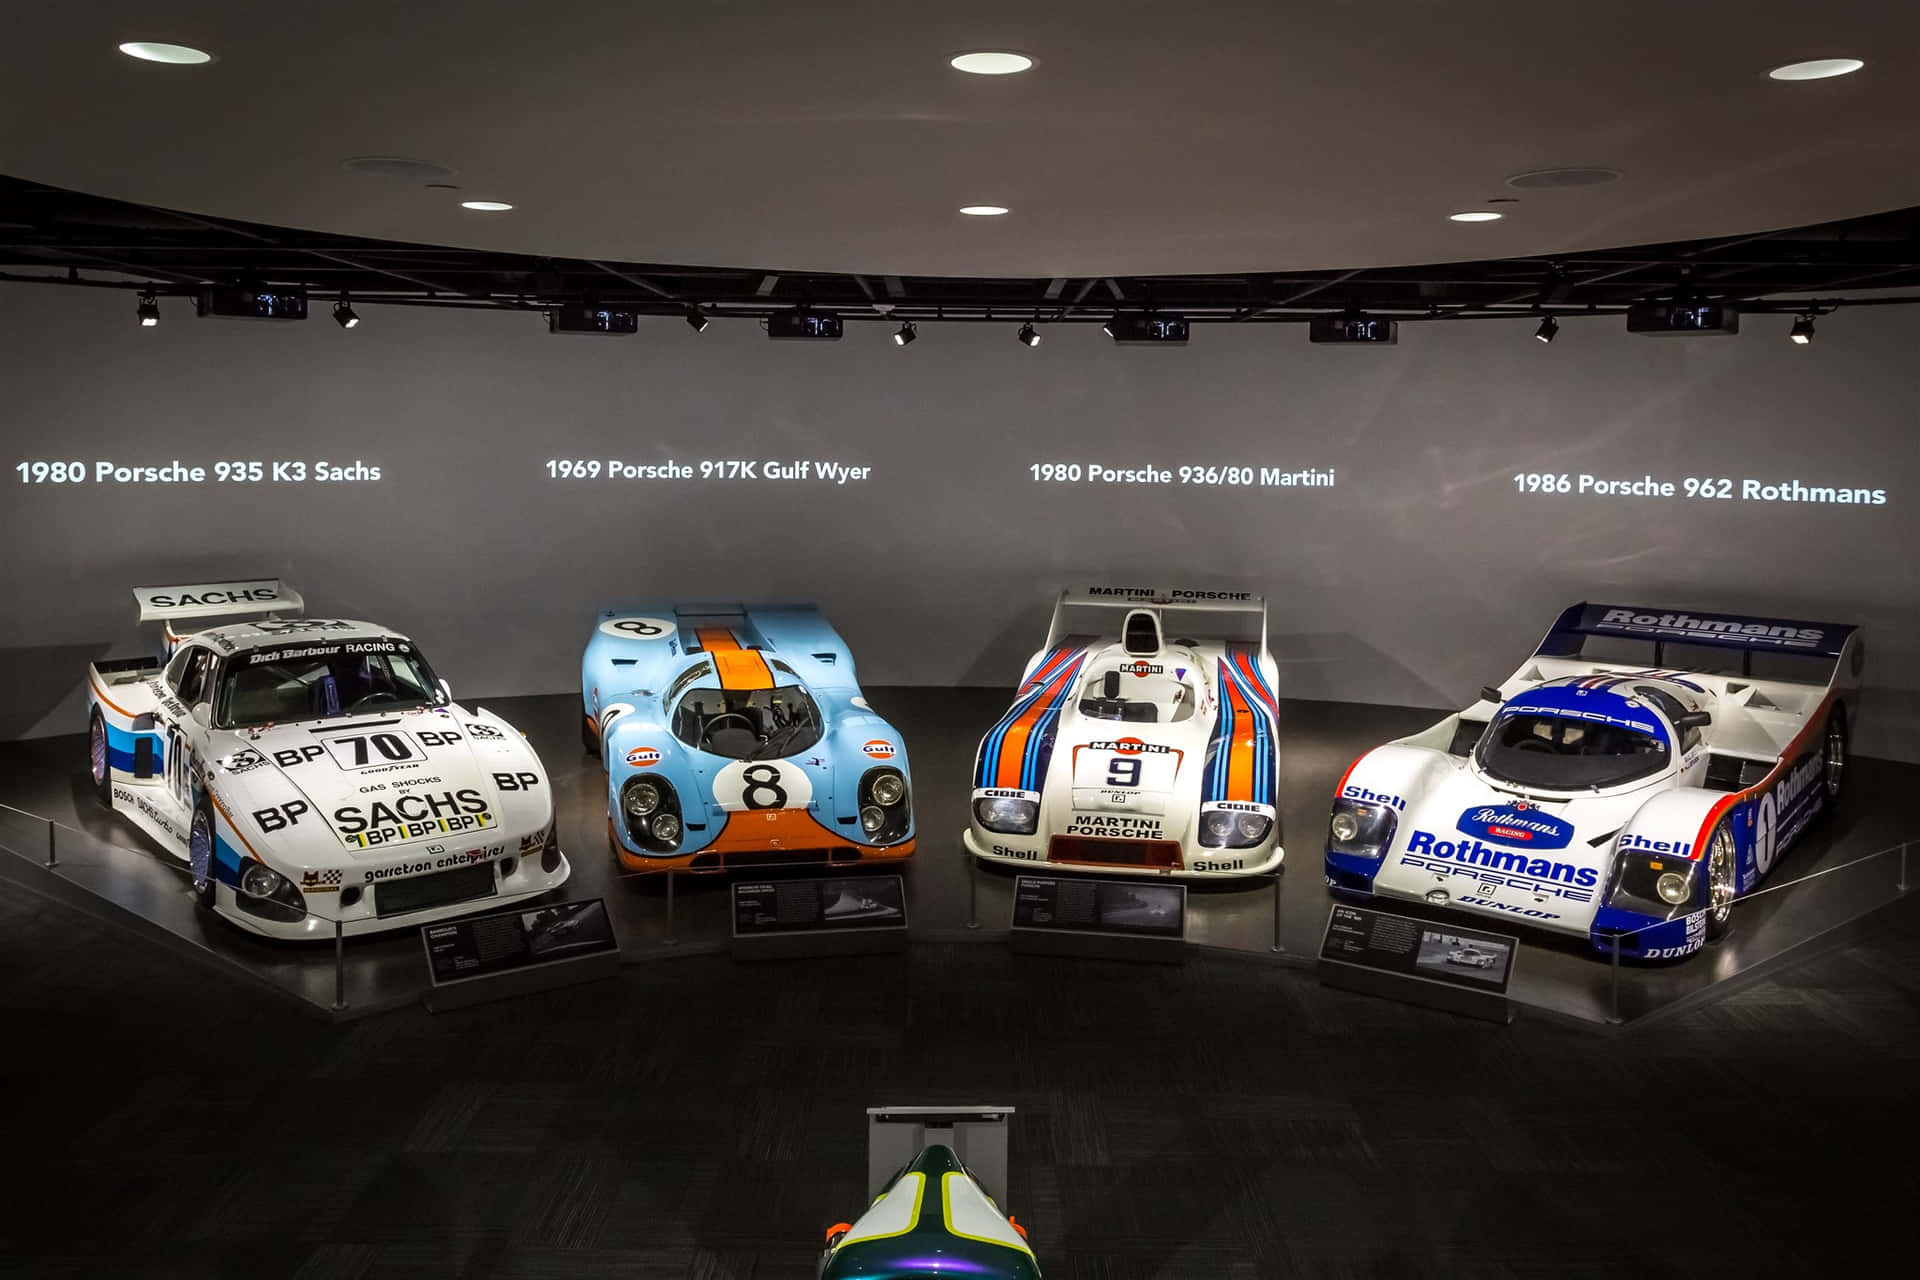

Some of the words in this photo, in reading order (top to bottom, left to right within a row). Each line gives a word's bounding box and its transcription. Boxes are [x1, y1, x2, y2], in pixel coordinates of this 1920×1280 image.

[16, 462, 86, 483] 1980
[96, 461, 206, 483] Porsche
[214, 462, 264, 482] 935
[272, 462, 307, 482] K3
[315, 460, 382, 481] Sachs
[546, 460, 601, 479] 1969
[608, 460, 694, 480] Porsche
[700, 461, 757, 480] 917K
[763, 460, 809, 480] Gulf
[814, 463, 871, 484] Wyer
[1030, 464, 1082, 482] 1980
[1088, 465, 1173, 484] Porsche
[1179, 466, 1254, 486] 936/80
[1260, 468, 1336, 487] Martini
[1513, 474, 1571, 494] 1986
[1578, 475, 1676, 497] Porsche
[1684, 478, 1733, 499] 962
[1742, 480, 1887, 505] Rothmans
[151, 588, 279, 608] SACHS
[1089, 587, 1155, 597] MARTINI
[1172, 589, 1251, 601] PORSCHE
[613, 620, 663, 636] 8
[1602, 609, 1825, 641] Rothmans
[250, 652, 281, 665] Dick
[282, 645, 341, 660] Barbour
[345, 641, 396, 654] RACING
[1121, 664, 1163, 674] MARTINI
[1502, 705, 1655, 733] PORSCHE
[334, 733, 413, 766] 70
[416, 731, 463, 747] BP
[863, 743, 896, 755] Gulf
[1091, 741, 1168, 754] MARTINI
[273, 744, 326, 768] BP
[625, 752, 661, 763] Gulf
[492, 771, 539, 792] BP
[1106, 757, 1142, 787] 9
[359, 783, 387, 795] GAS
[391, 776, 442, 789] SHOCKS
[742, 764, 788, 811] 8
[984, 789, 1026, 799] CIBIE
[1217, 802, 1261, 813] CIBIE
[1344, 786, 1408, 812] Shell
[252, 799, 309, 835] BP
[334, 789, 489, 834] SACHS
[1075, 815, 1161, 829] MARTINI
[1472, 808, 1561, 837] Rothmans
[408, 820, 437, 838] BP
[447, 814, 476, 832] BP
[1066, 825, 1164, 840] PORSCHE
[1495, 827, 1526, 839] RACING
[366, 827, 397, 846] BP
[1618, 833, 1692, 857] Shell
[993, 844, 1038, 862] Shell
[1407, 829, 1600, 887] Rothmans
[364, 860, 431, 884] garretson
[1193, 859, 1244, 873] Shell
[1400, 857, 1595, 903] PORSCHE
[1456, 895, 1561, 921] DUNLOP
